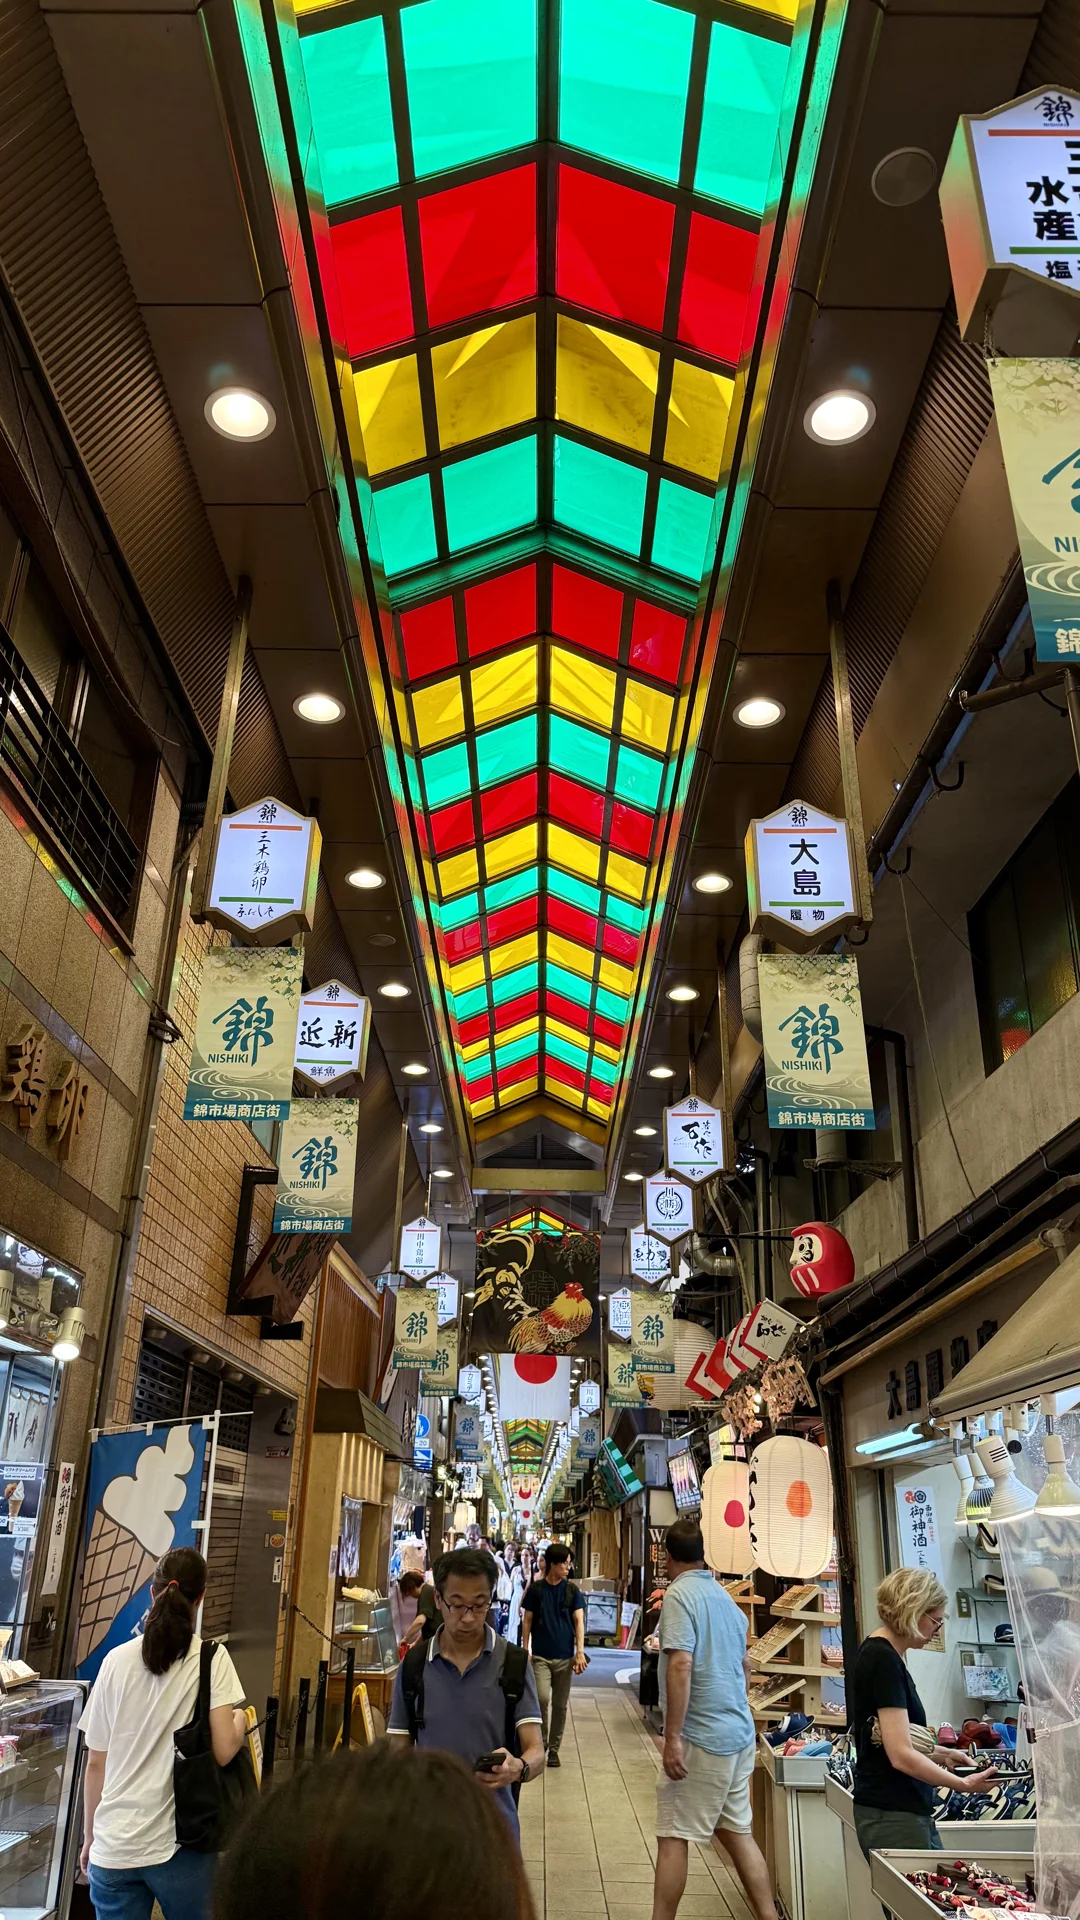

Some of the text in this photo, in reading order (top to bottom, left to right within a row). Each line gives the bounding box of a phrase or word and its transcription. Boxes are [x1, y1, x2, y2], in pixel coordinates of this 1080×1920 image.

[1034, 95, 1075, 127] 錦
[1025, 176, 1078, 241] 水産
[257, 803, 277, 823] 錦
[787, 806, 808, 827] 錦
[251, 830, 271, 895] 三木鶏卵
[788, 838, 821, 897] 大島
[790, 909, 825, 921] 履物
[325, 985, 340, 1001] 錦
[211, 995, 275, 1067] 錦
[299, 1017, 358, 1050] 近新
[778, 1003, 844, 1074] 錦
[207, 1053, 249, 1064] NISHIKI
[310, 1066, 336, 1077] 鮮魚
[781, 1060, 823, 1072] NISHIKI
[193, 1104, 281, 1118] 錦市場商店街
[778, 1111, 865, 1127] 錦市場商店街
[292, 1136, 338, 1191] 錦
[289, 1181, 320, 1190] NISHIKI
[280, 1220, 345, 1231] 錦市場商店街
[401, 1311, 428, 1345] 錦
[638, 1314, 665, 1347] 錦
[613, 1362, 635, 1389] 錦
[910, 1505, 927, 1547] 御神酒
